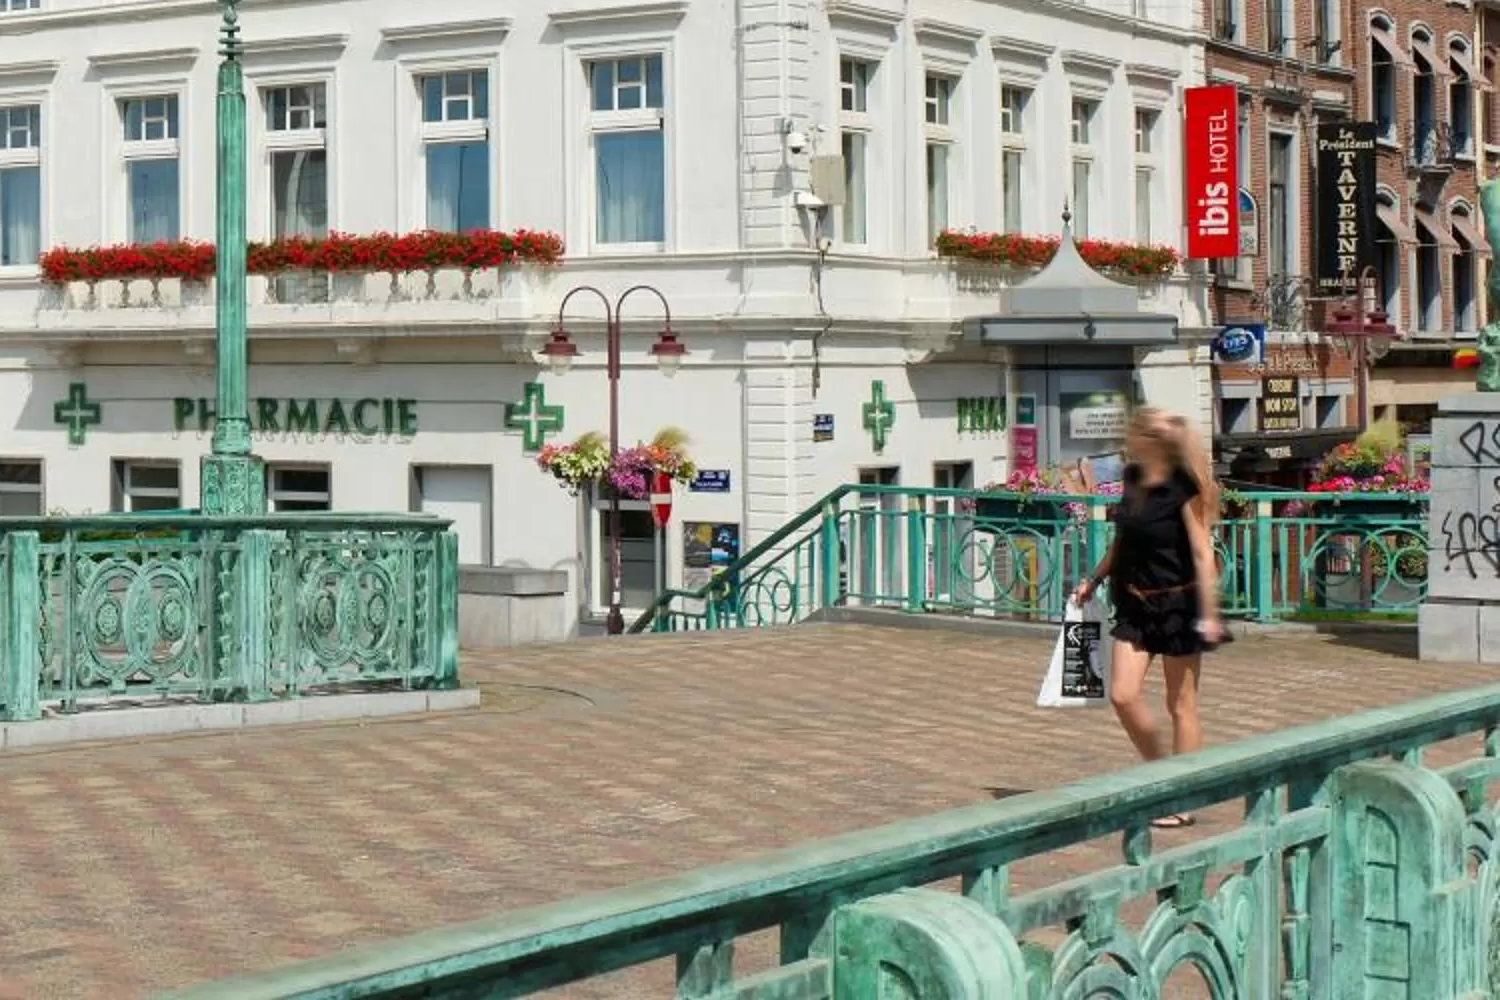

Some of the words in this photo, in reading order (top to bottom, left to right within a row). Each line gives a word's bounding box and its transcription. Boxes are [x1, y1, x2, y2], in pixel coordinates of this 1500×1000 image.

[1209, 109, 1229, 174] HOTEL
[1198, 181, 1229, 236] ibis
[1337, 151, 1358, 271] TAVERNE
[173, 397, 418, 436] PHRMACIE
